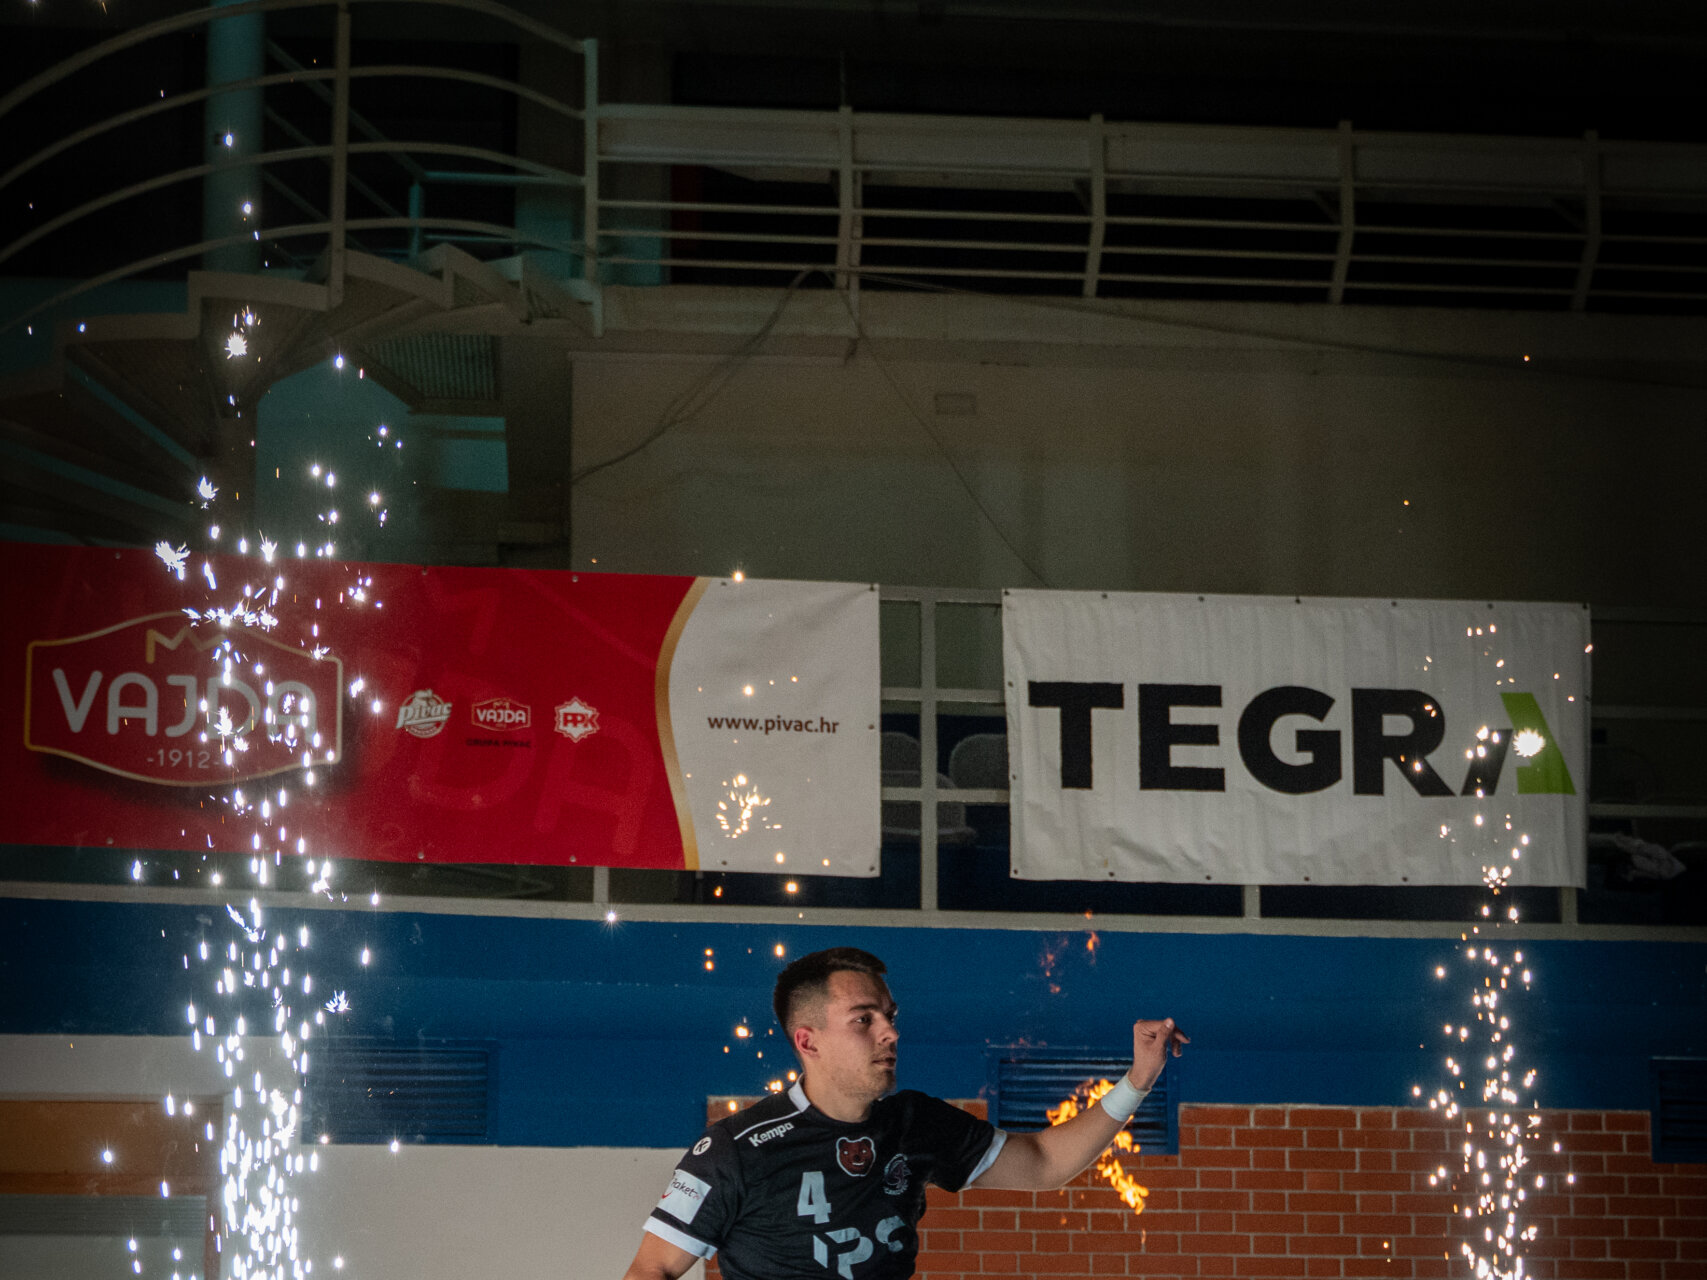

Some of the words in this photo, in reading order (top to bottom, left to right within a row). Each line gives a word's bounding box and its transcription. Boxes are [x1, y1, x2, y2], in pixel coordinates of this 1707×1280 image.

[52, 668, 319, 744] VAJDA
[476, 708, 527, 724] VAJDA
[707, 714, 839, 735] www.pivac.hr
[1028, 680, 1577, 798] TEGRA
[748, 1122, 795, 1147] Kempa
[796, 1171, 832, 1225] 4
